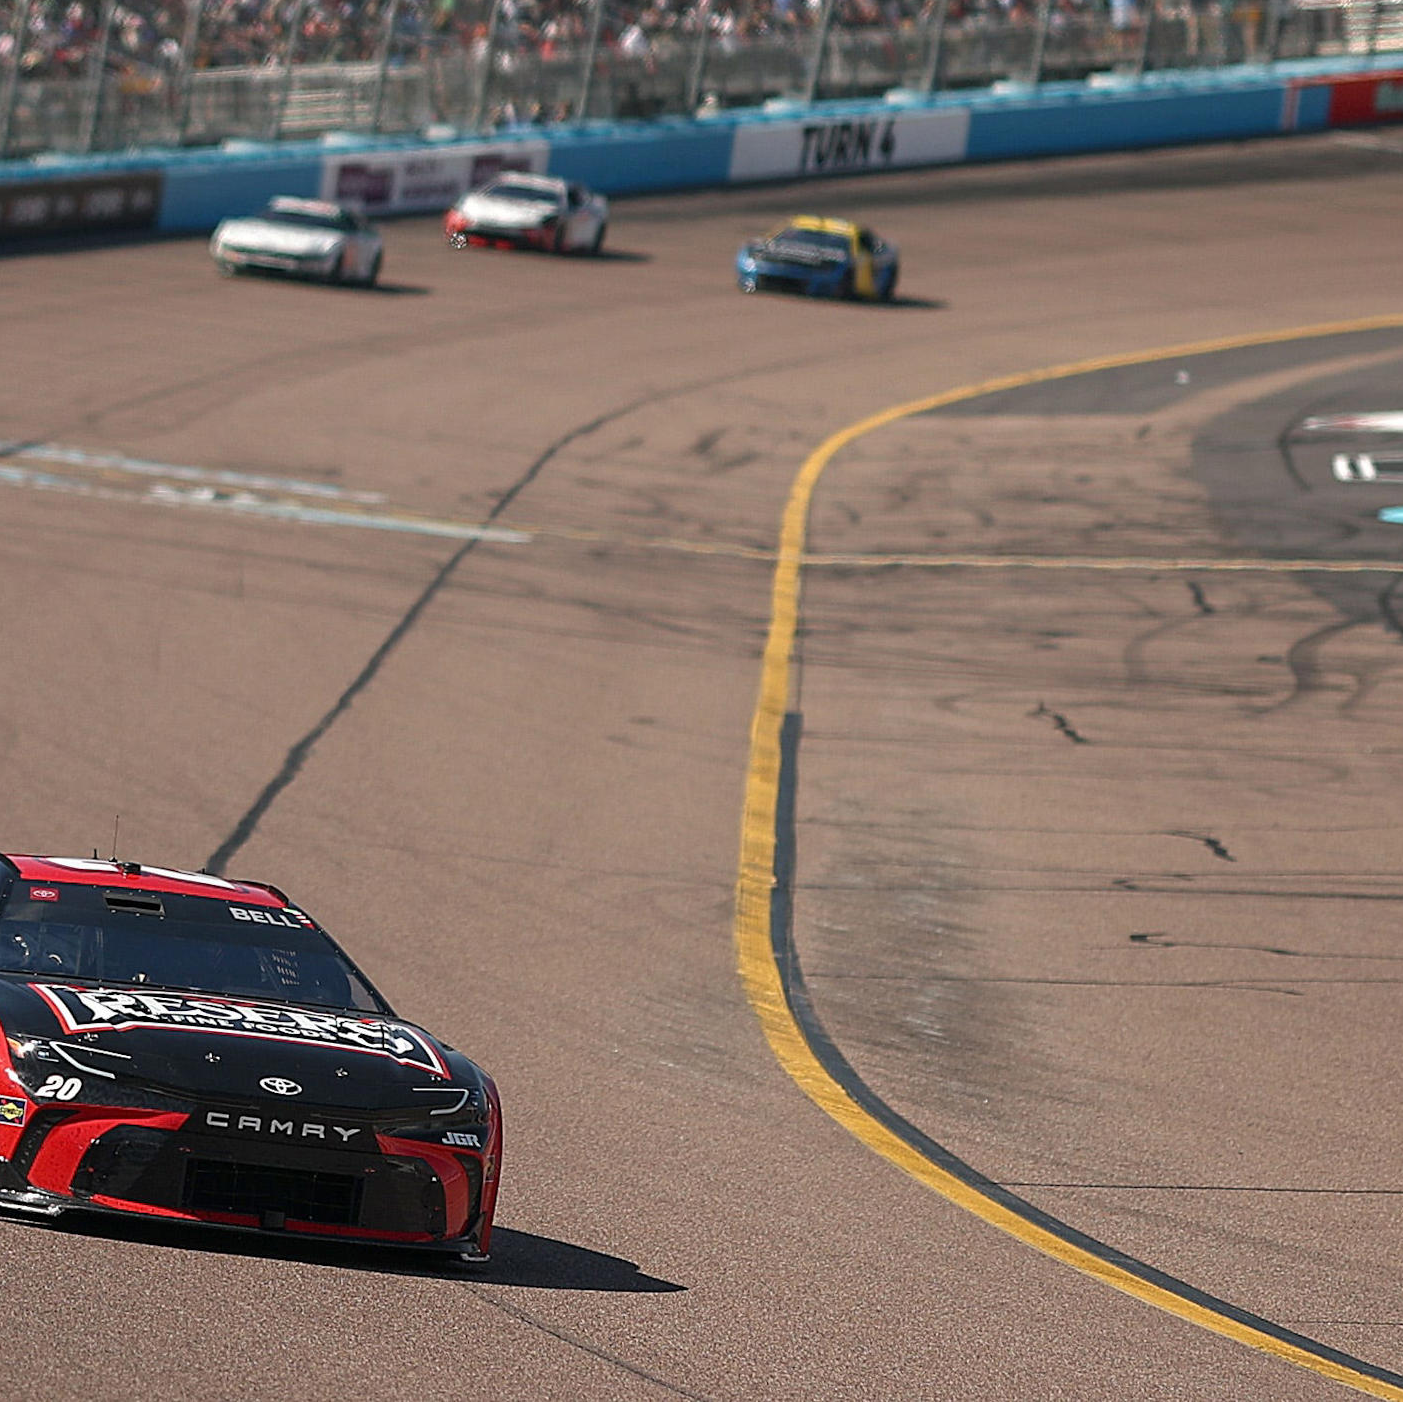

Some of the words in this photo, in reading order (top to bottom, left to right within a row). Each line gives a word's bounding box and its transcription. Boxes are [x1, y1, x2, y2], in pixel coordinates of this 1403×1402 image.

[801, 122, 875, 172] TURN
[229, 907, 301, 928] BELL
[173, 1014, 231, 1029] FINE
[242, 1020, 336, 1041] FOODS
[35, 1075, 82, 1100] 20
[206, 1111, 361, 1141] CAMRY
[442, 1131, 481, 1148] JGR
